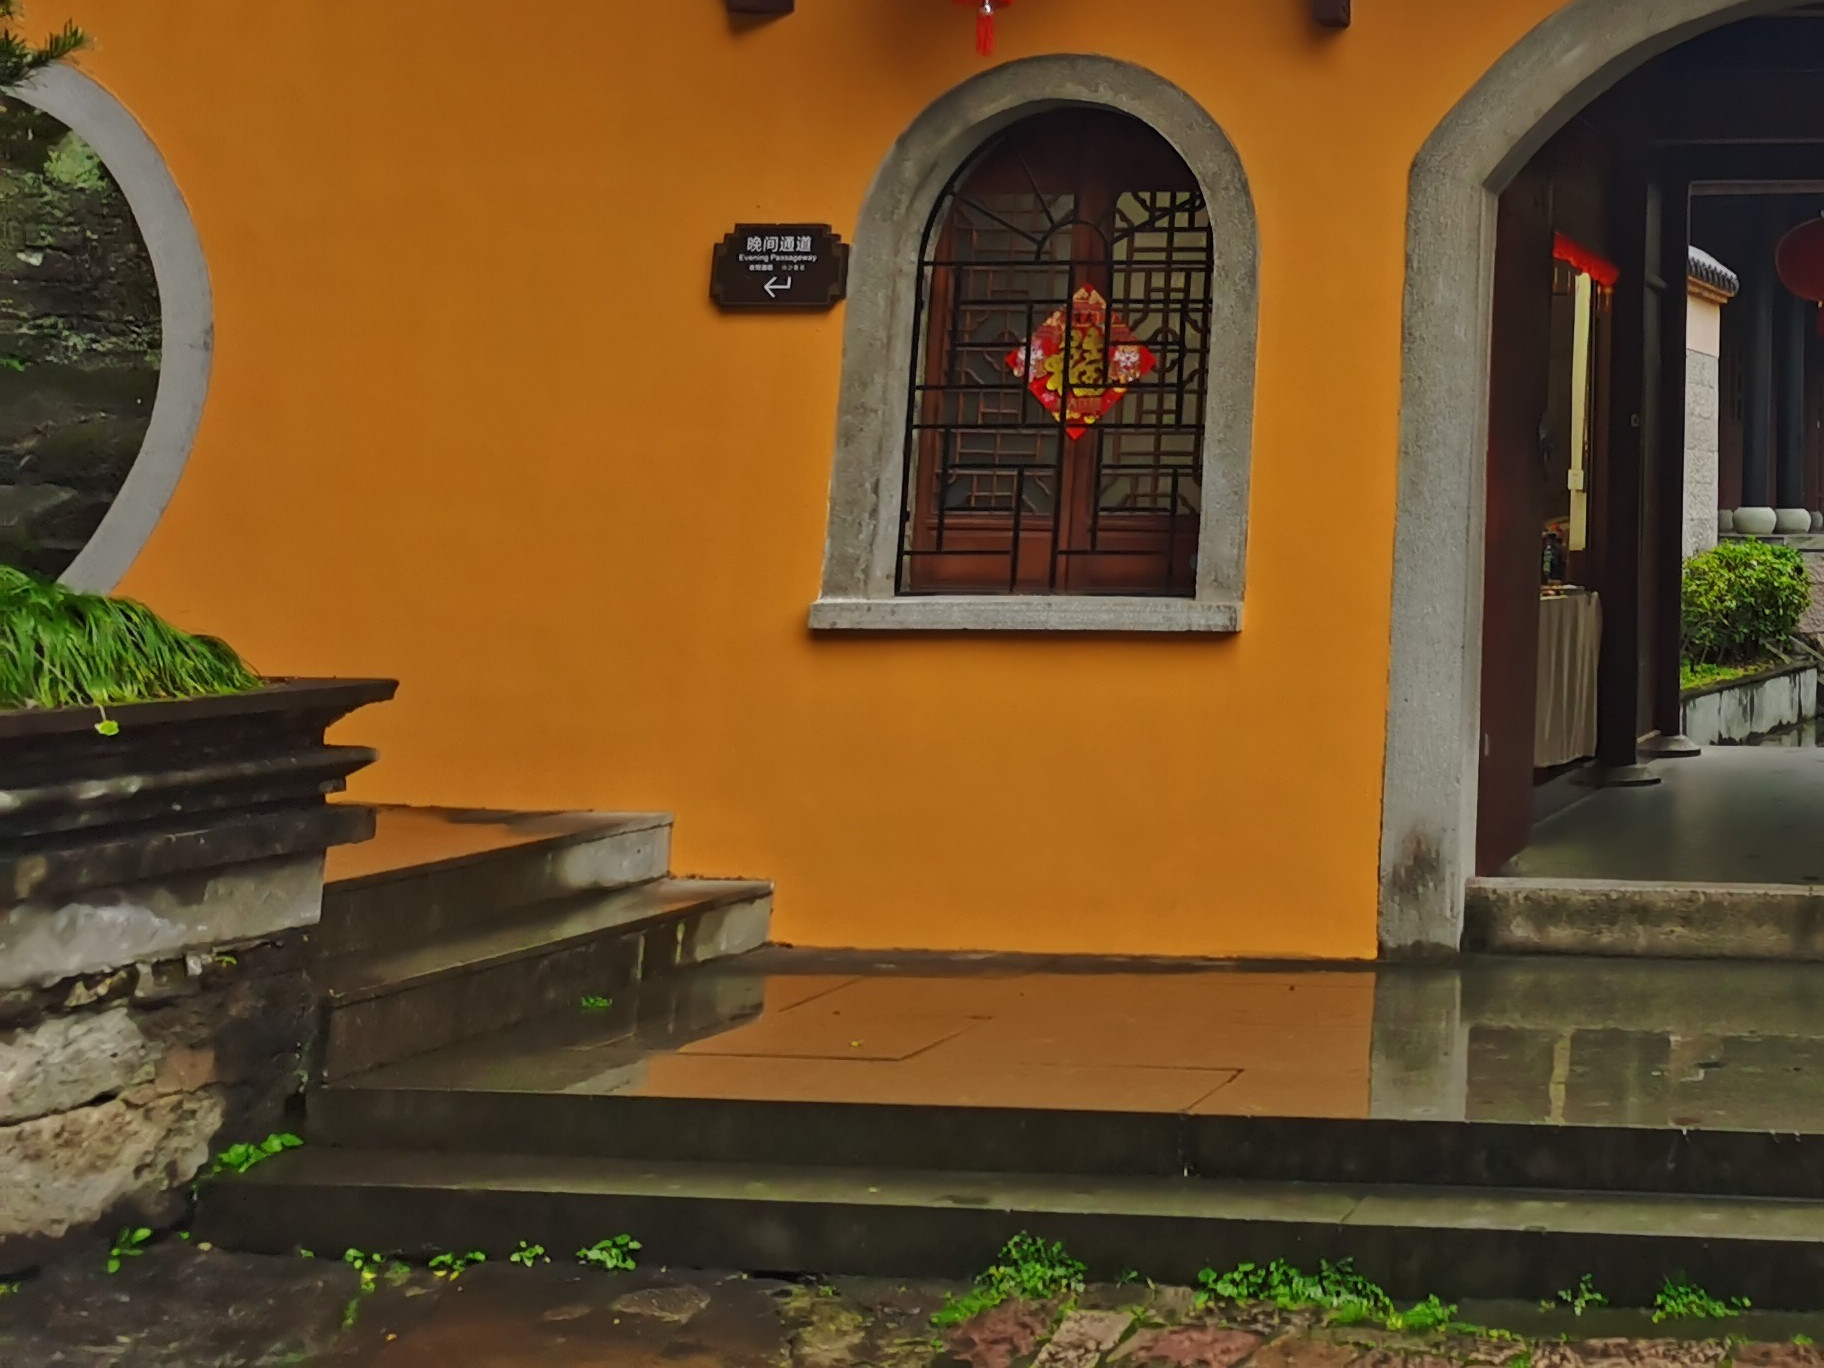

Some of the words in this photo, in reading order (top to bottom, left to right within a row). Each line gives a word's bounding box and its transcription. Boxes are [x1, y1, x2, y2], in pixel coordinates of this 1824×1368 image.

[747, 236, 811, 252] 晚间通道
[739, 254, 769, 262] Evening
[770, 254, 817, 262] Passageway
